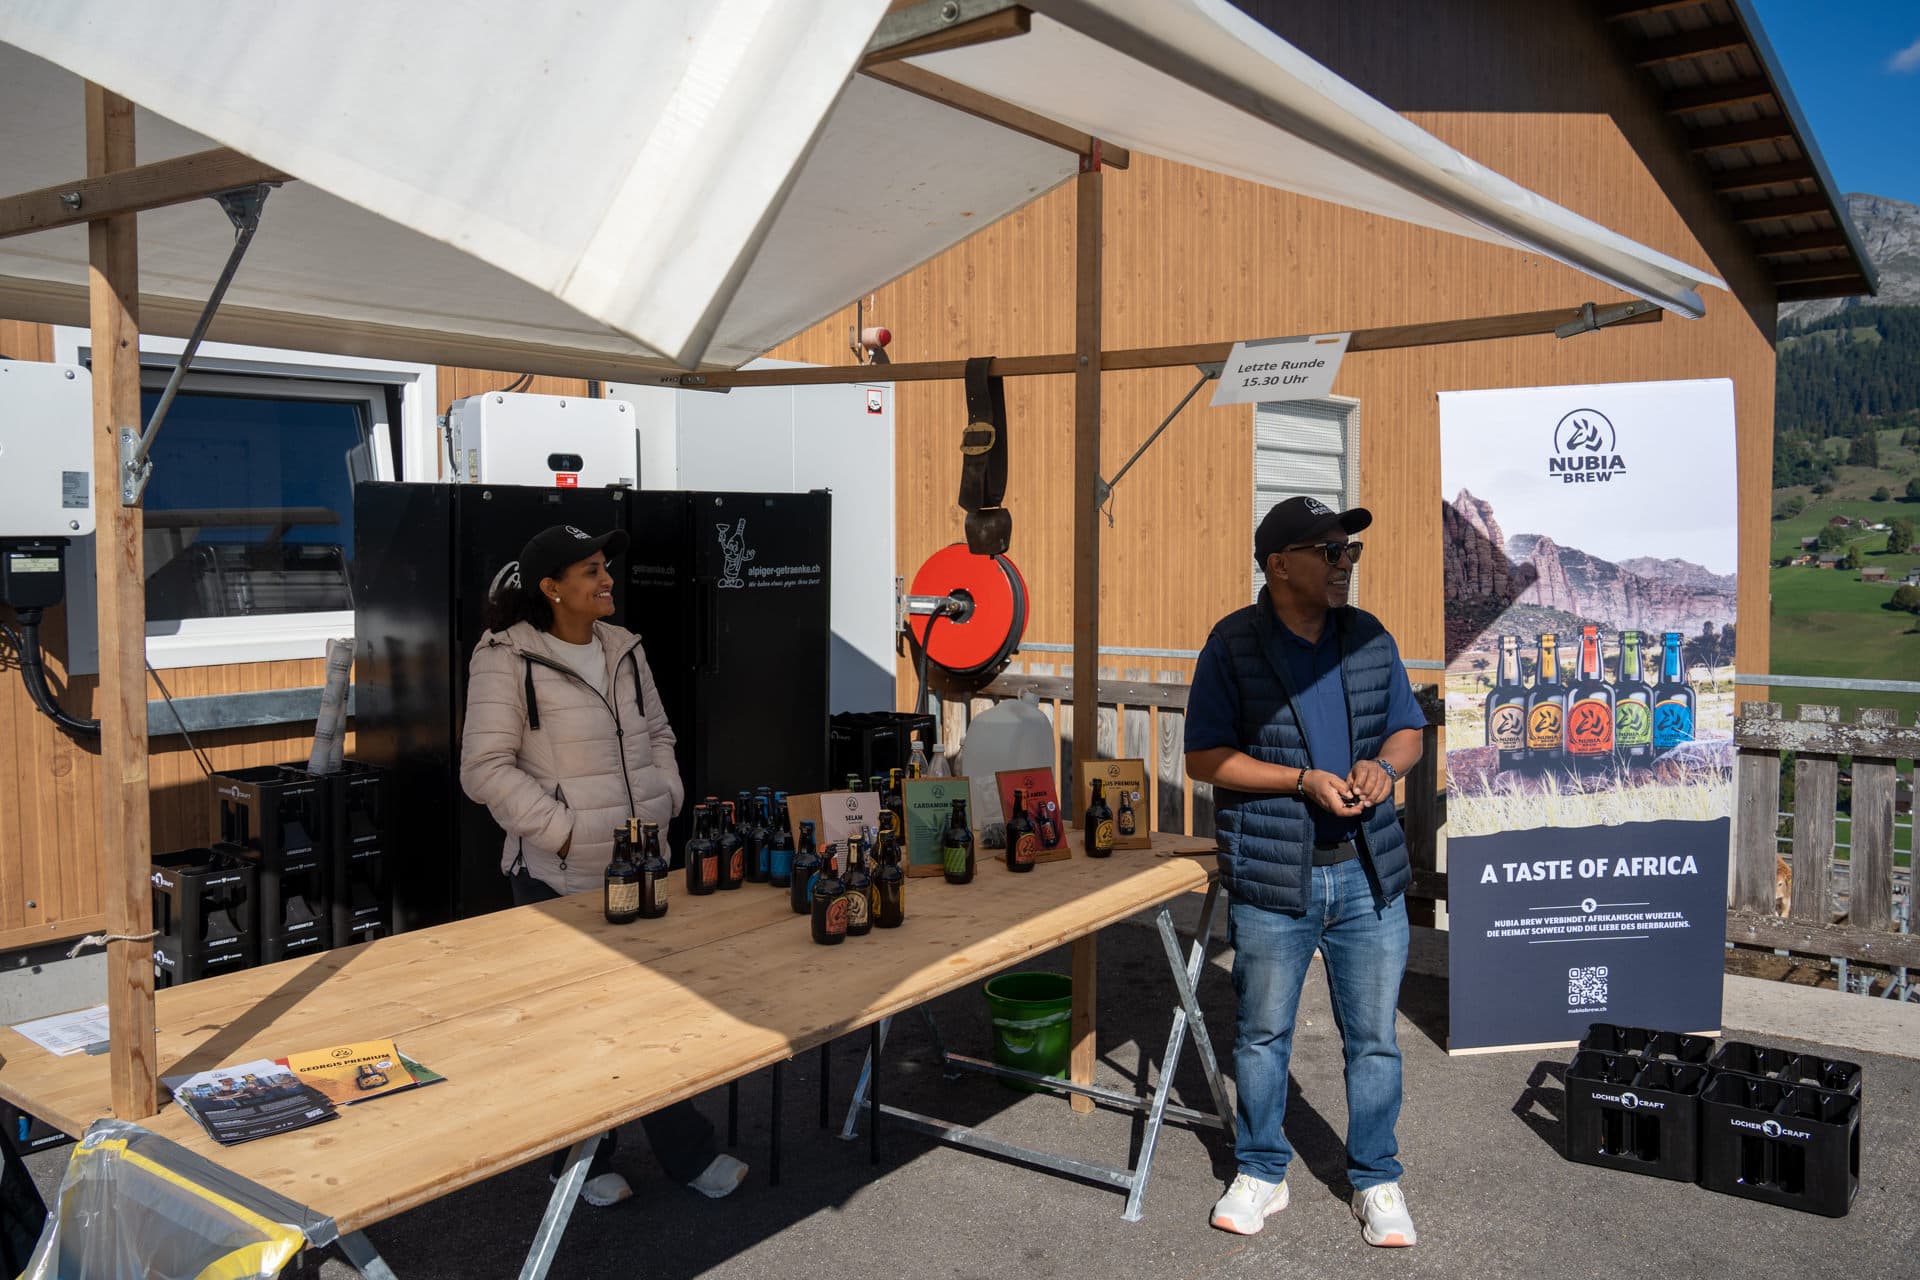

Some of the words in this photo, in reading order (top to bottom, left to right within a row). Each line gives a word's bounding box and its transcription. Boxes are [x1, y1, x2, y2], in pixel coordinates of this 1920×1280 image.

[1237, 362, 1278, 373] Letzte
[1280, 358, 1325, 370] Runde
[1241, 377, 1280, 387] 15.30
[1282, 375, 1309, 385] Uhr
[1549, 455, 1626, 472] NUBIA
[1563, 471, 1612, 483] BREW
[1480, 864, 1498, 884] A
[1502, 860, 1573, 882] TASTE
[1578, 858, 1609, 878] OF
[1613, 855, 1698, 877] AFRICA
[1494, 919, 1520, 927] NUBIA
[1520, 918, 1542, 926] BREW
[1544, 915, 1587, 924] VERBINDET
[1588, 913, 1644, 922] AFRIKANISCHE
[1645, 911, 1684, 920] WURZELN,
[1501, 928, 1530, 937] HEIMAT
[1531, 926, 1566, 935] SCHWEIZ
[1566, 925, 1583, 933] UND
[1584, 924, 1598, 932] DIE
[1599, 923, 1620, 931] LIEBE
[1621, 922, 1636, 930] DES
[1636, 920, 1691, 930] BIERBRAUENS.
[299, 1061, 342, 1073] GEORGIS
[344, 1053, 391, 1065] PREMIUM
[1591, 1092, 1620, 1102] LOCHER
[1638, 1100, 1665, 1109] CRAFT
[1730, 1119, 1762, 1130] LOCHER
[1782, 1129, 1811, 1139] CRAFT
